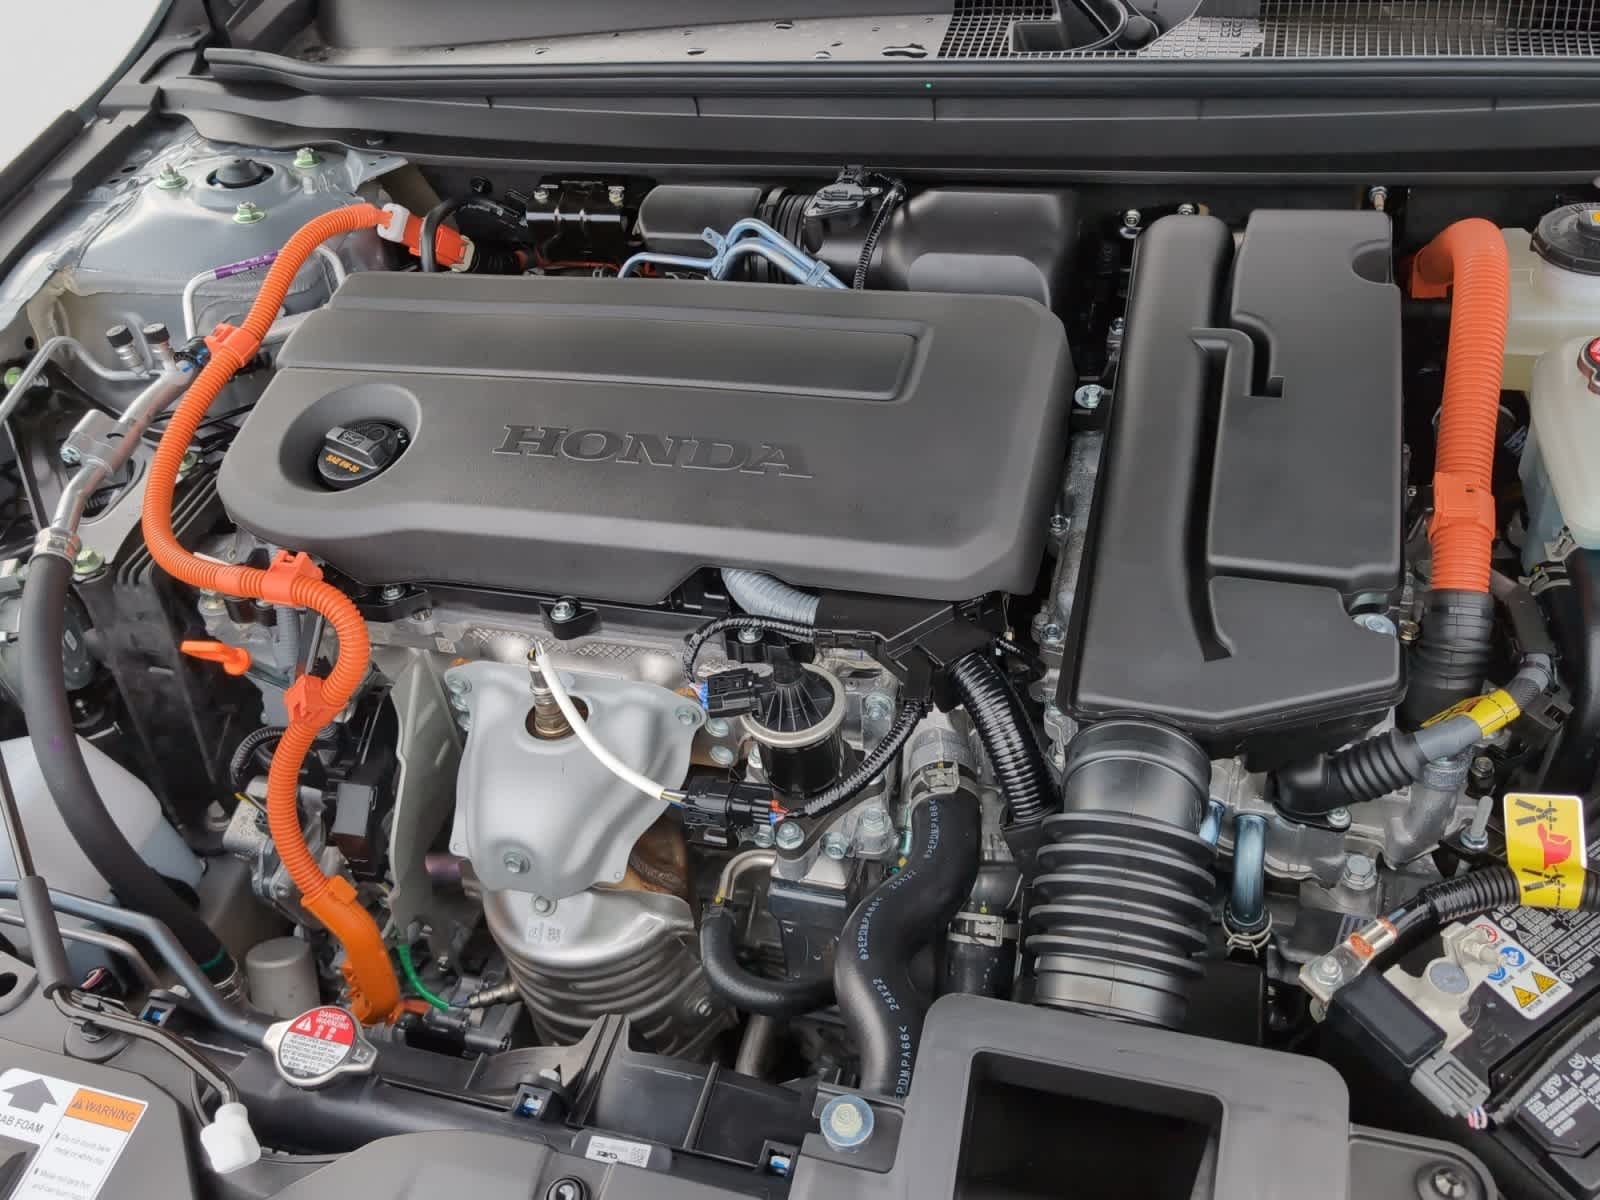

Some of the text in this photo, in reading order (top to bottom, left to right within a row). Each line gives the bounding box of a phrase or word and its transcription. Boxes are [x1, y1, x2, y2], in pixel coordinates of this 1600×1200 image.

[492, 424, 813, 479] HONDA
[85, 1100, 136, 1122] WARNING
[14, 1117, 45, 1134] FOAM
